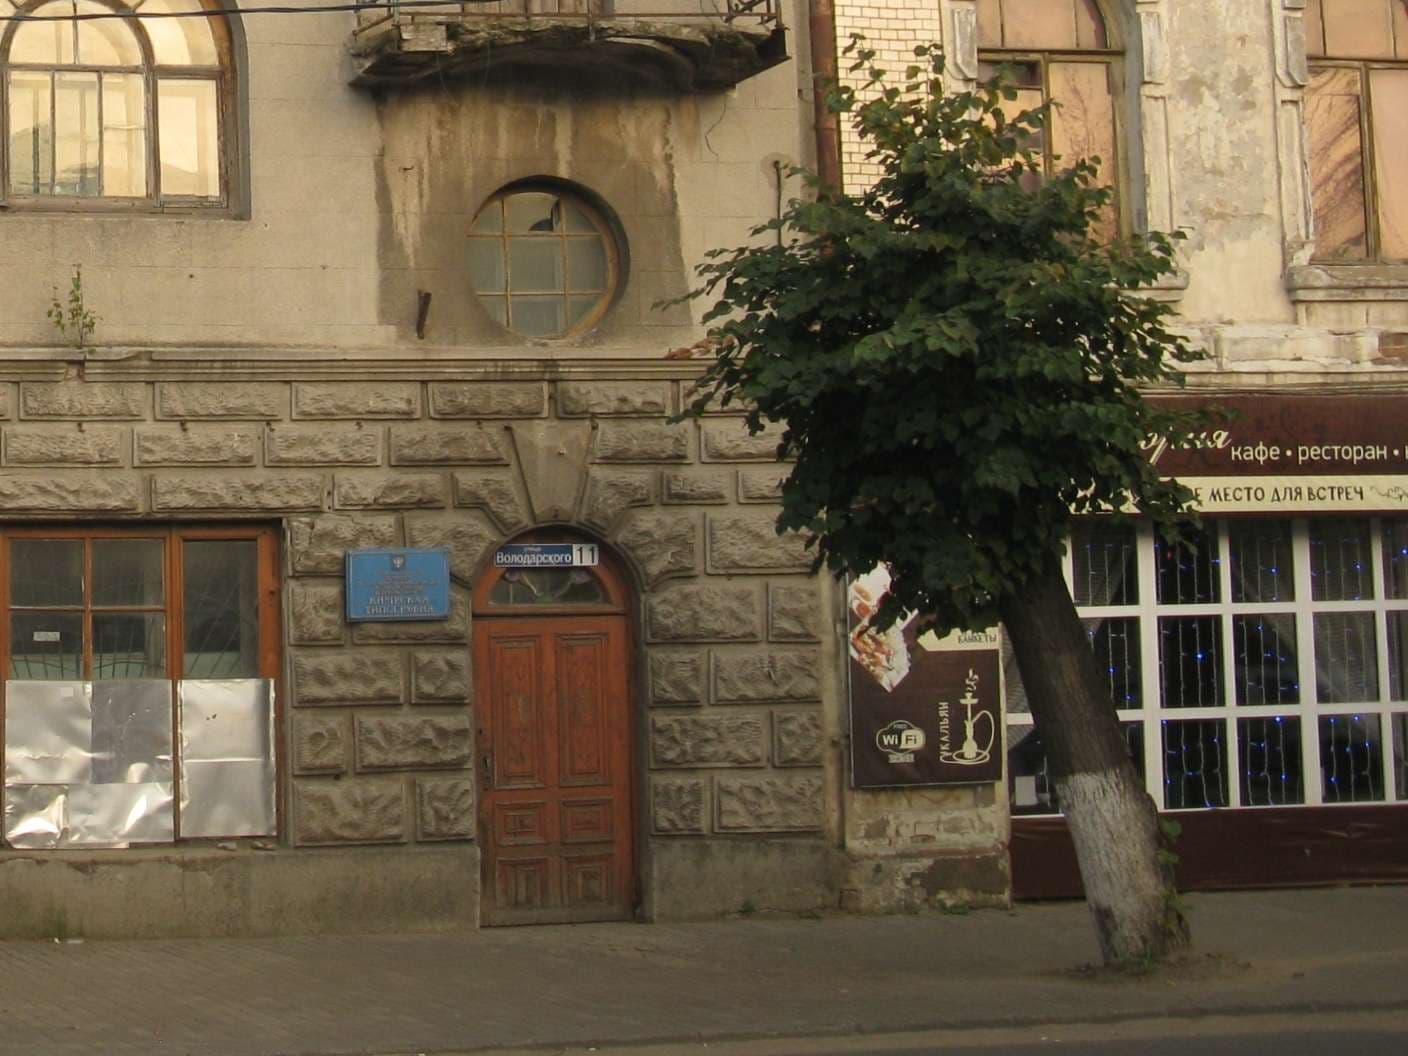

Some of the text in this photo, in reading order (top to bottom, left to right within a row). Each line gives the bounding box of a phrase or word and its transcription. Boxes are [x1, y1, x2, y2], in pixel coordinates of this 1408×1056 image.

[1231, 441, 1280, 464] кафе
[1297, 445, 1388, 464] ресторан
[1209, 486, 1265, 502] МЕСТО
[1271, 486, 1302, 502] ДЛЯ
[1307, 486, 1364, 501] ВСТРЕЧ
[496, 551, 572, 567] Володарского
[576, 546, 596, 564] 11
[938, 701, 951, 751] КАЛЬЯН
